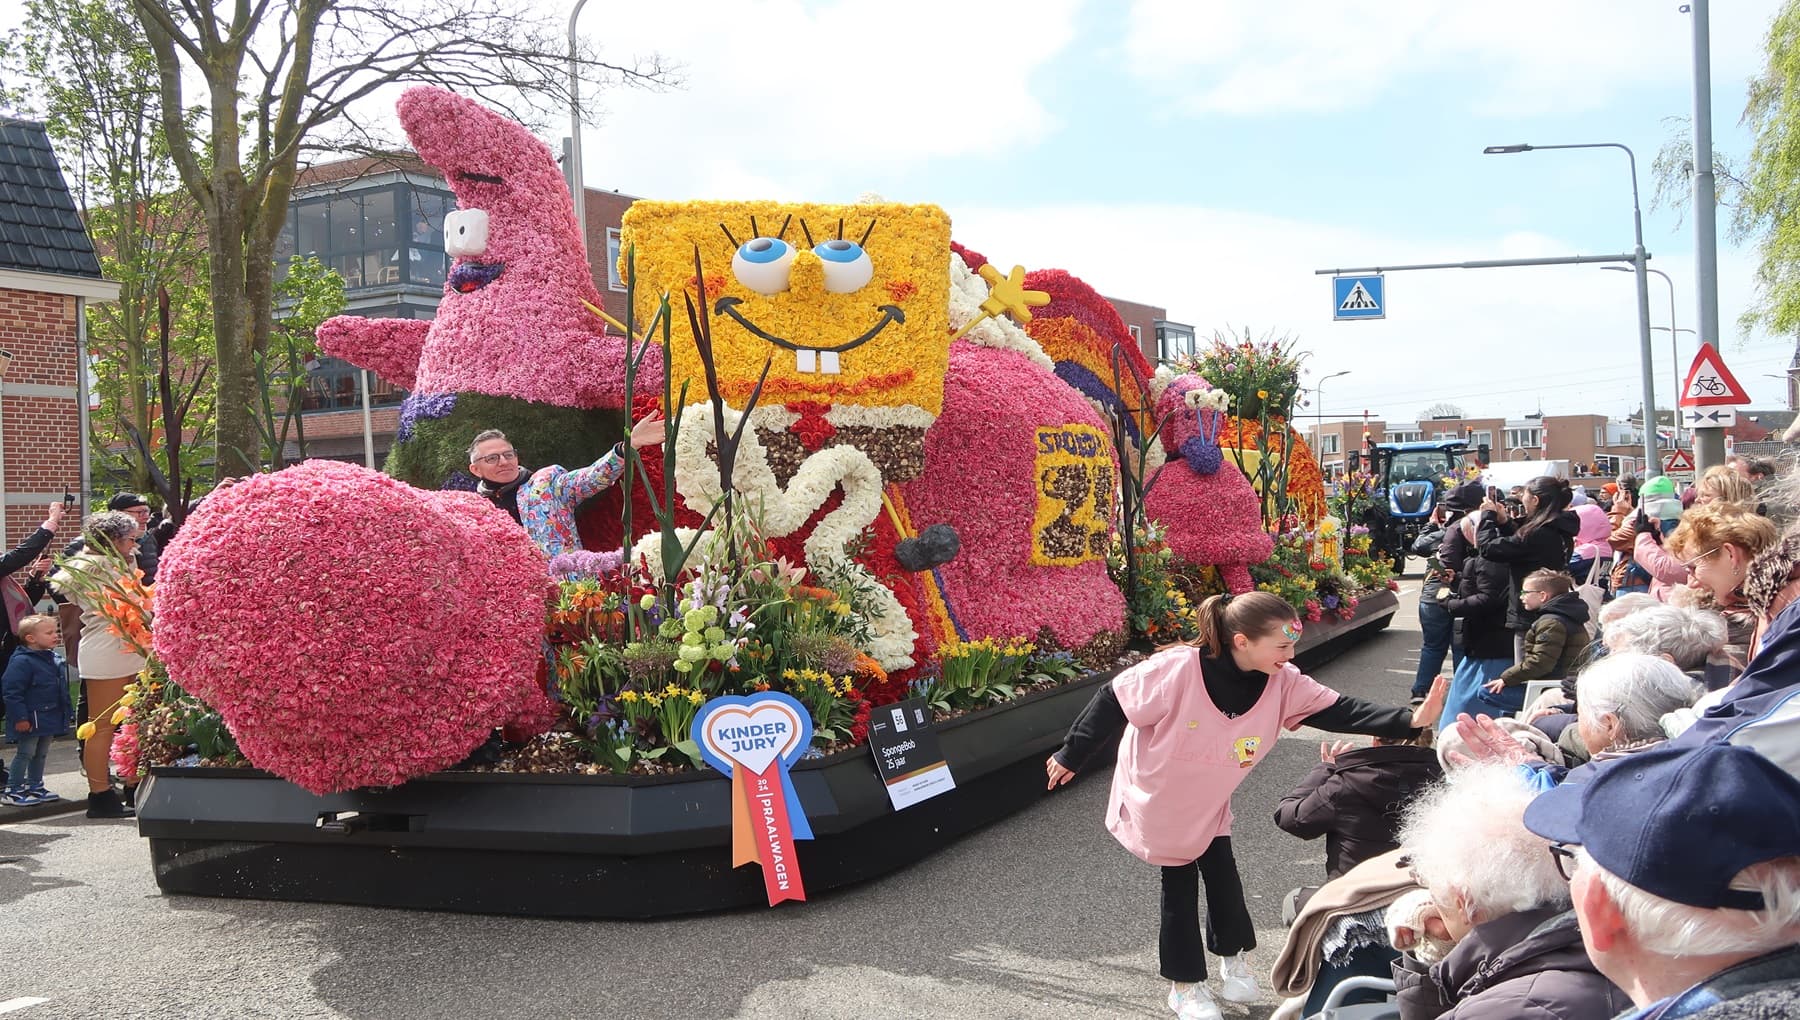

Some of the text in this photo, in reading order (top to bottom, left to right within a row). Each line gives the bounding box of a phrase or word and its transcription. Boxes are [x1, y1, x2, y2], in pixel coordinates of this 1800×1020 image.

[718, 722, 787, 740] KINDER
[731, 736, 777, 753] JURY
[881, 739, 916, 758] SpongeBob
[885, 756, 906, 770] 25 jaar
[761, 798, 789, 890] PRAALWAGEN
